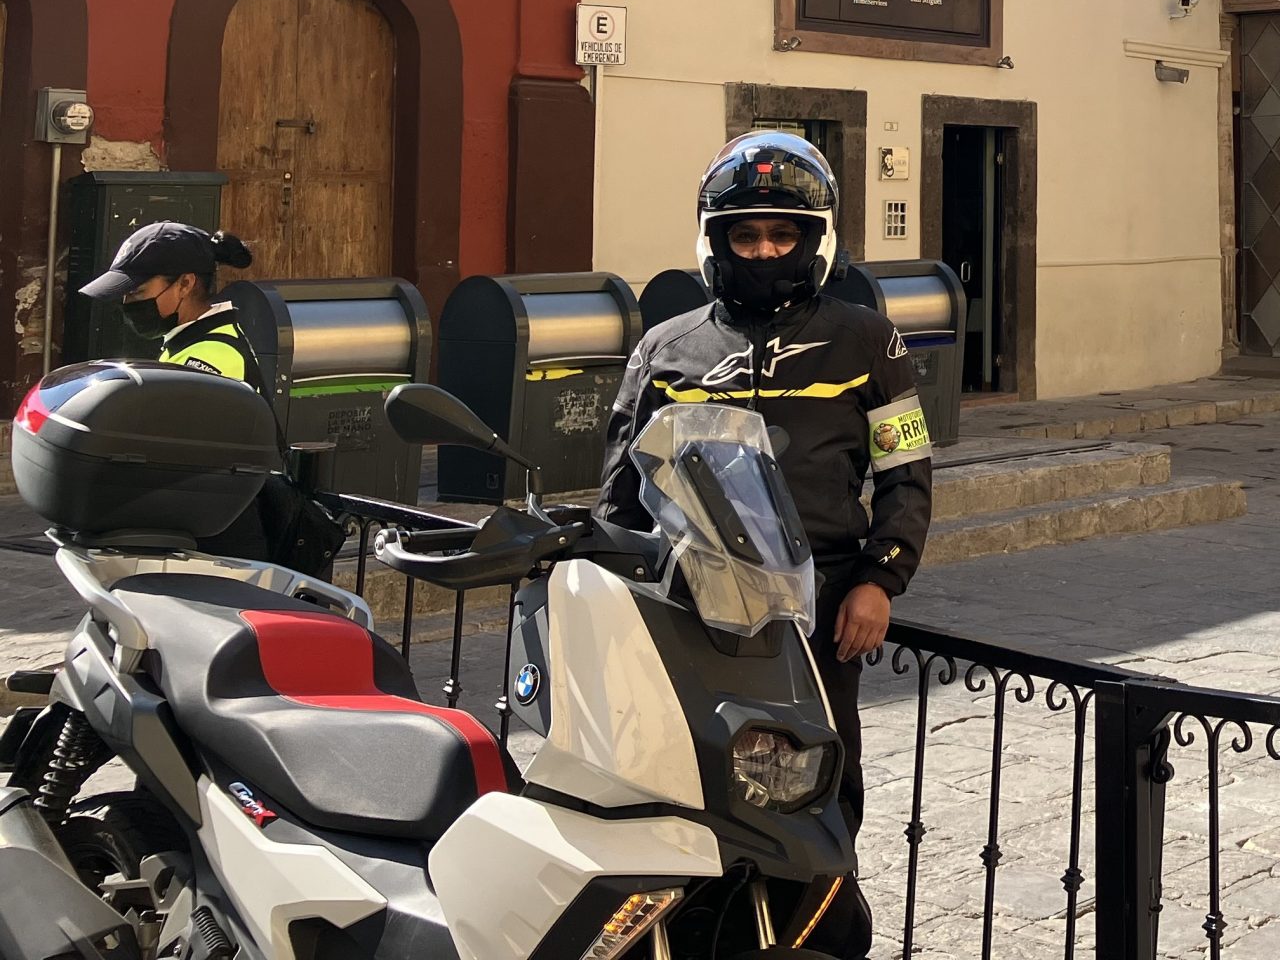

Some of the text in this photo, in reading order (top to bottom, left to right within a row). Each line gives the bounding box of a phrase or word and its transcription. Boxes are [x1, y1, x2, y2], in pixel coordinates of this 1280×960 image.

[596, 16, 608, 34] E
[581, 42, 622, 53] VEHICULOS DE
[583, 52, 619, 63] EMERGENCIA
